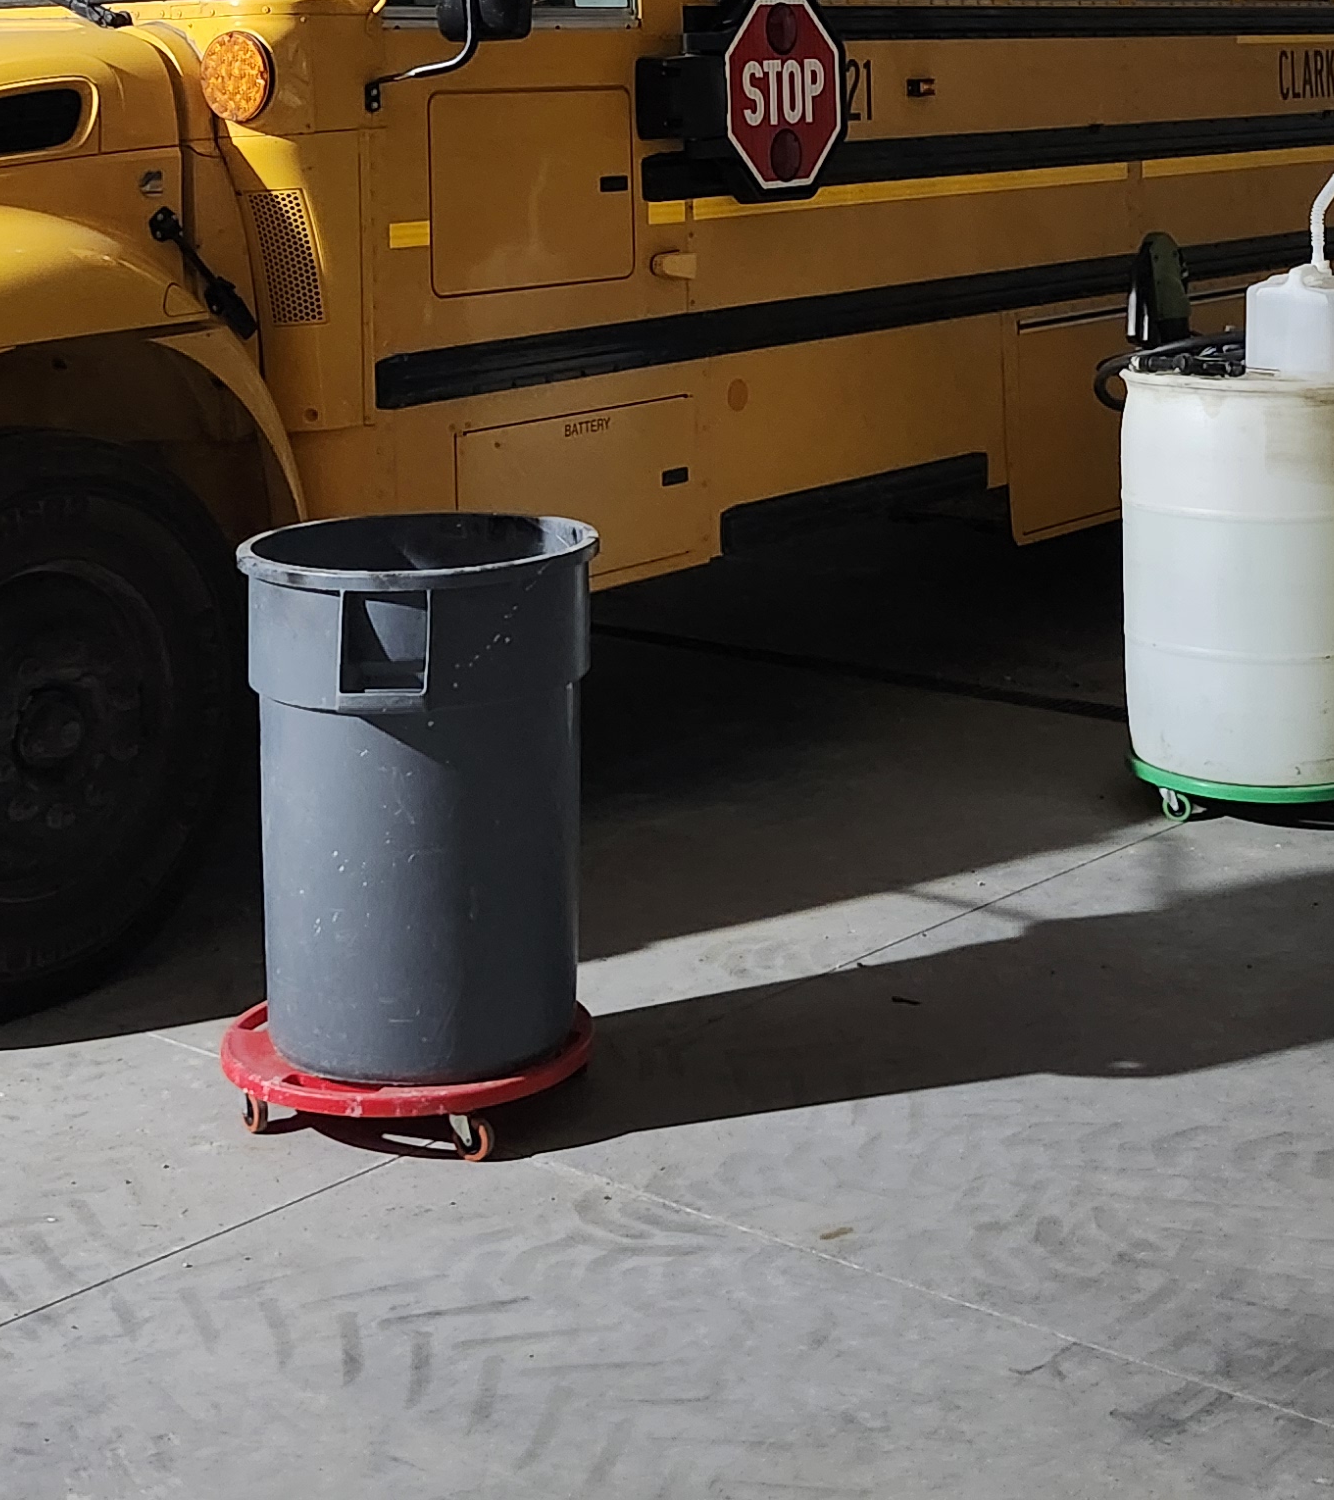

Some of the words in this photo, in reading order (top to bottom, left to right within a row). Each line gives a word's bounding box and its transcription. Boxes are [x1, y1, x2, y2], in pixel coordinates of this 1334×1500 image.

[742, 58, 825, 127] STOP
[844, 58, 873, 121] 21
[564, 417, 611, 438] BATTERY
